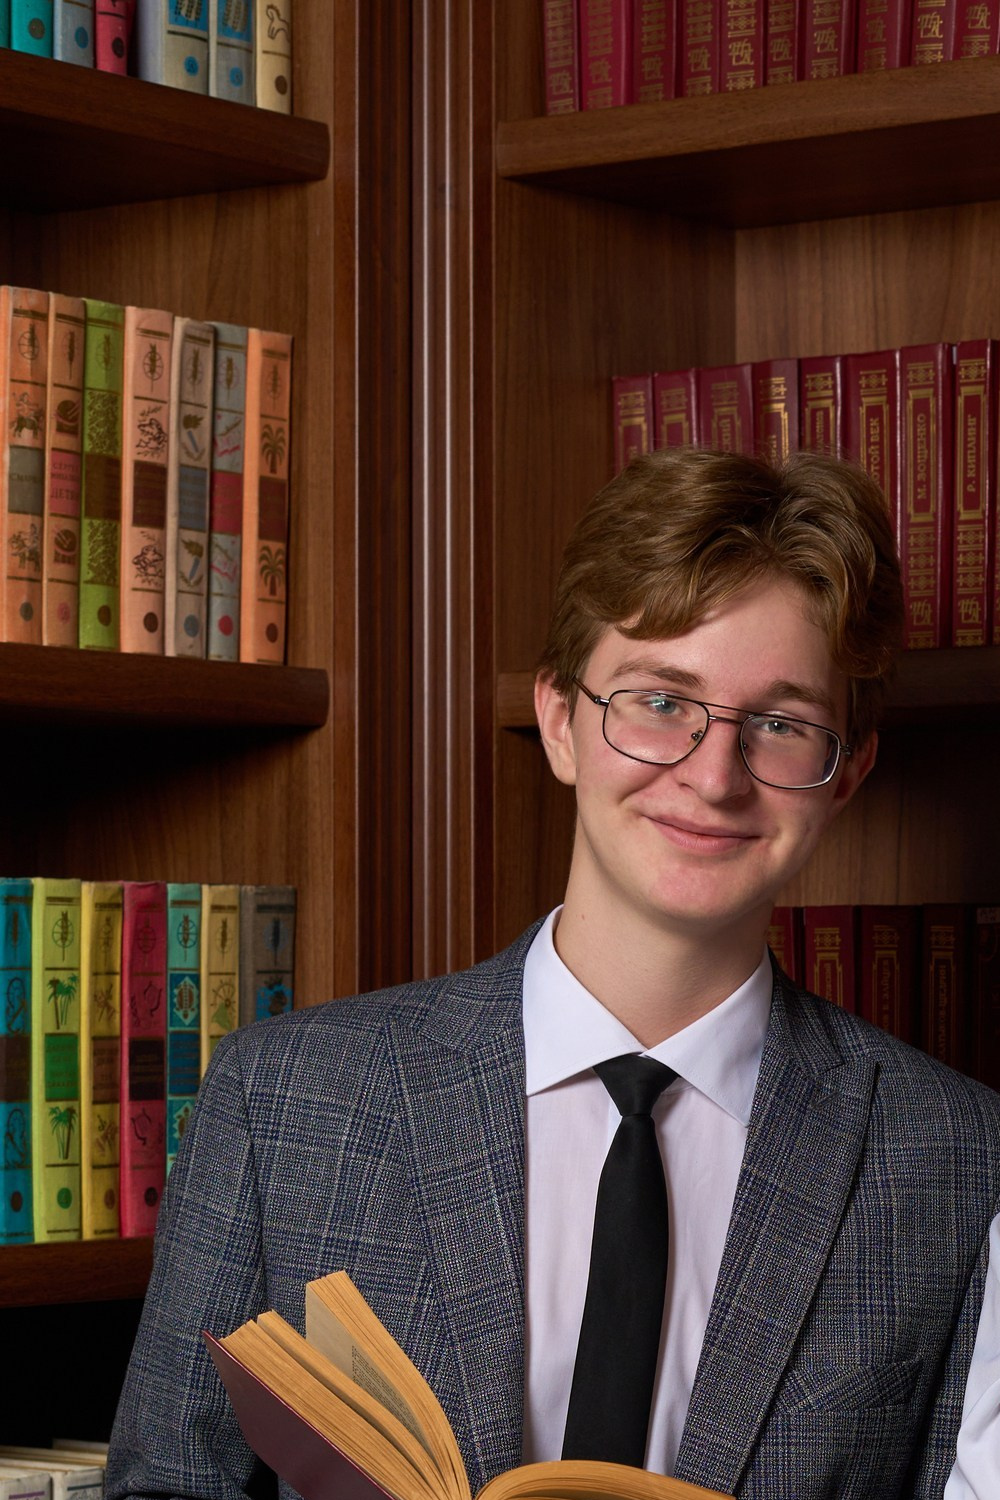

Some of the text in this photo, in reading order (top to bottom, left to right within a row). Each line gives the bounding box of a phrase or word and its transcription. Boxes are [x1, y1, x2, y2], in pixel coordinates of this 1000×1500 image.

[869, 417, 880, 442] ВЕК
[916, 413, 929, 499] М. ЗОЩЕНКО
[967, 414, 977, 493] Р. КИПЛИНГ
